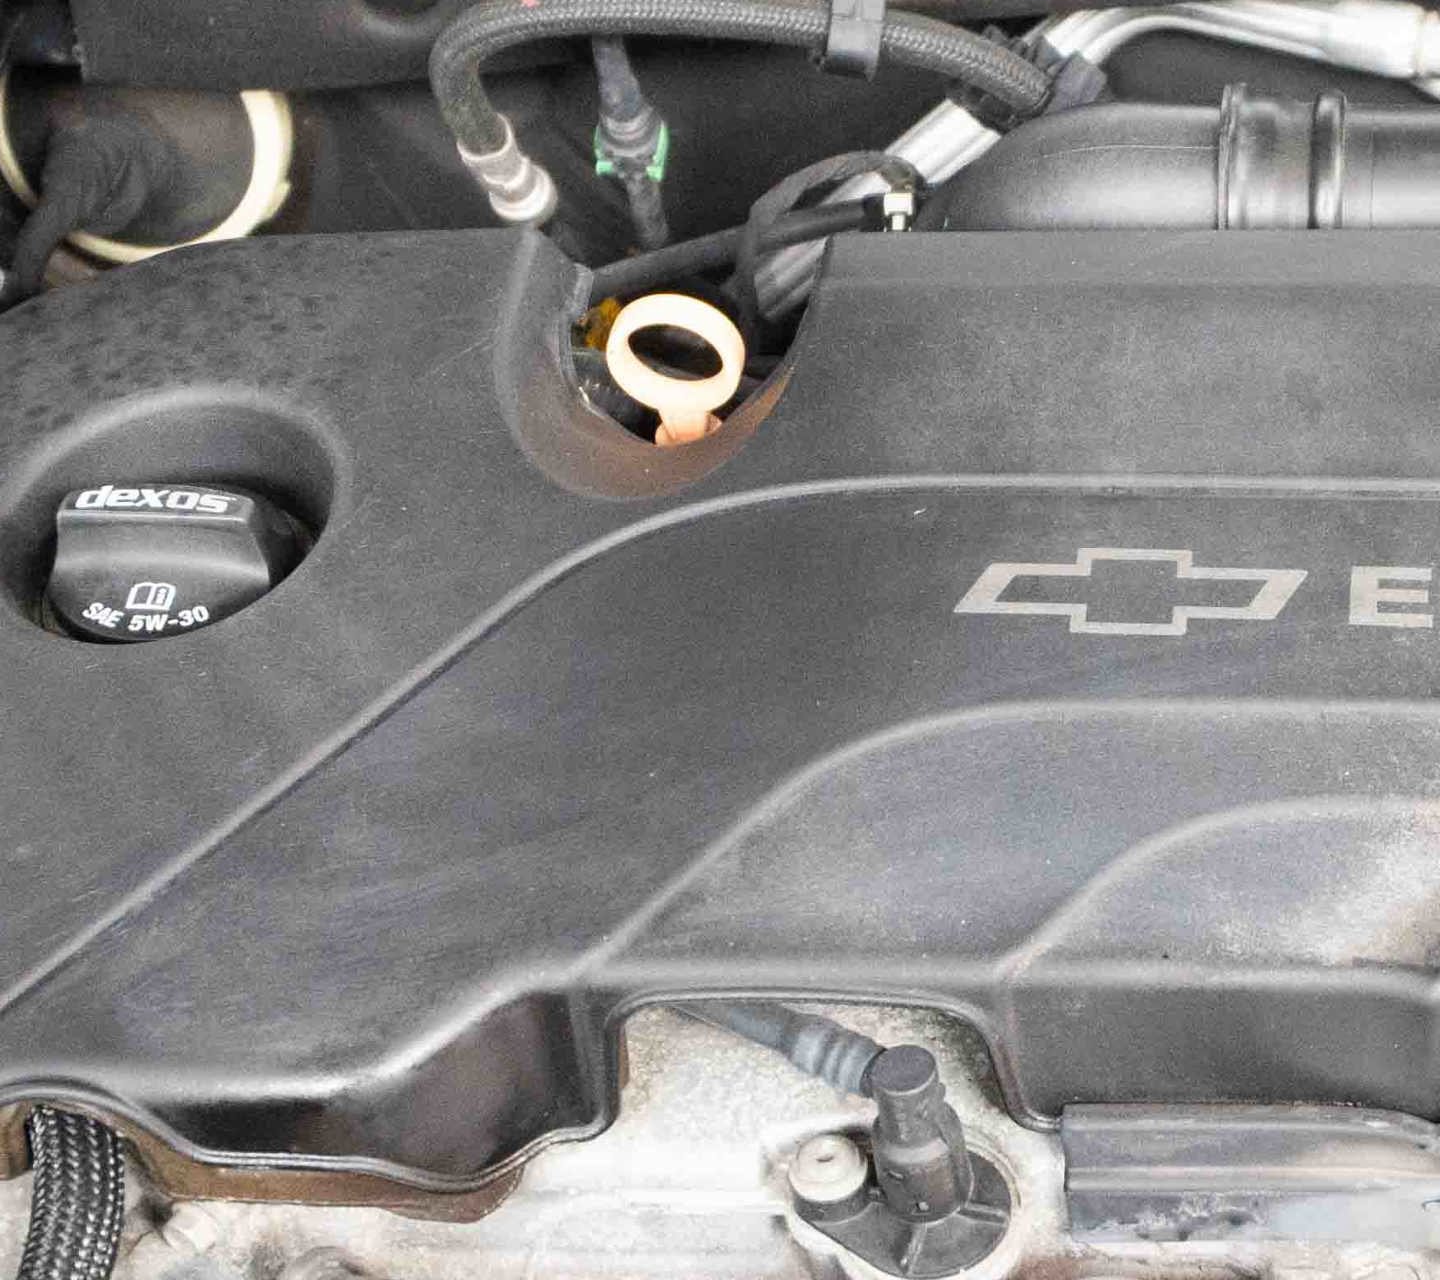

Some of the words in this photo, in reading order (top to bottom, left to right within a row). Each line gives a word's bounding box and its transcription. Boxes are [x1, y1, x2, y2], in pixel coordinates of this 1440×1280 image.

[75, 484, 233, 513] dexos
[82, 602, 124, 628] SAE
[128, 605, 209, 631] 5W-30
